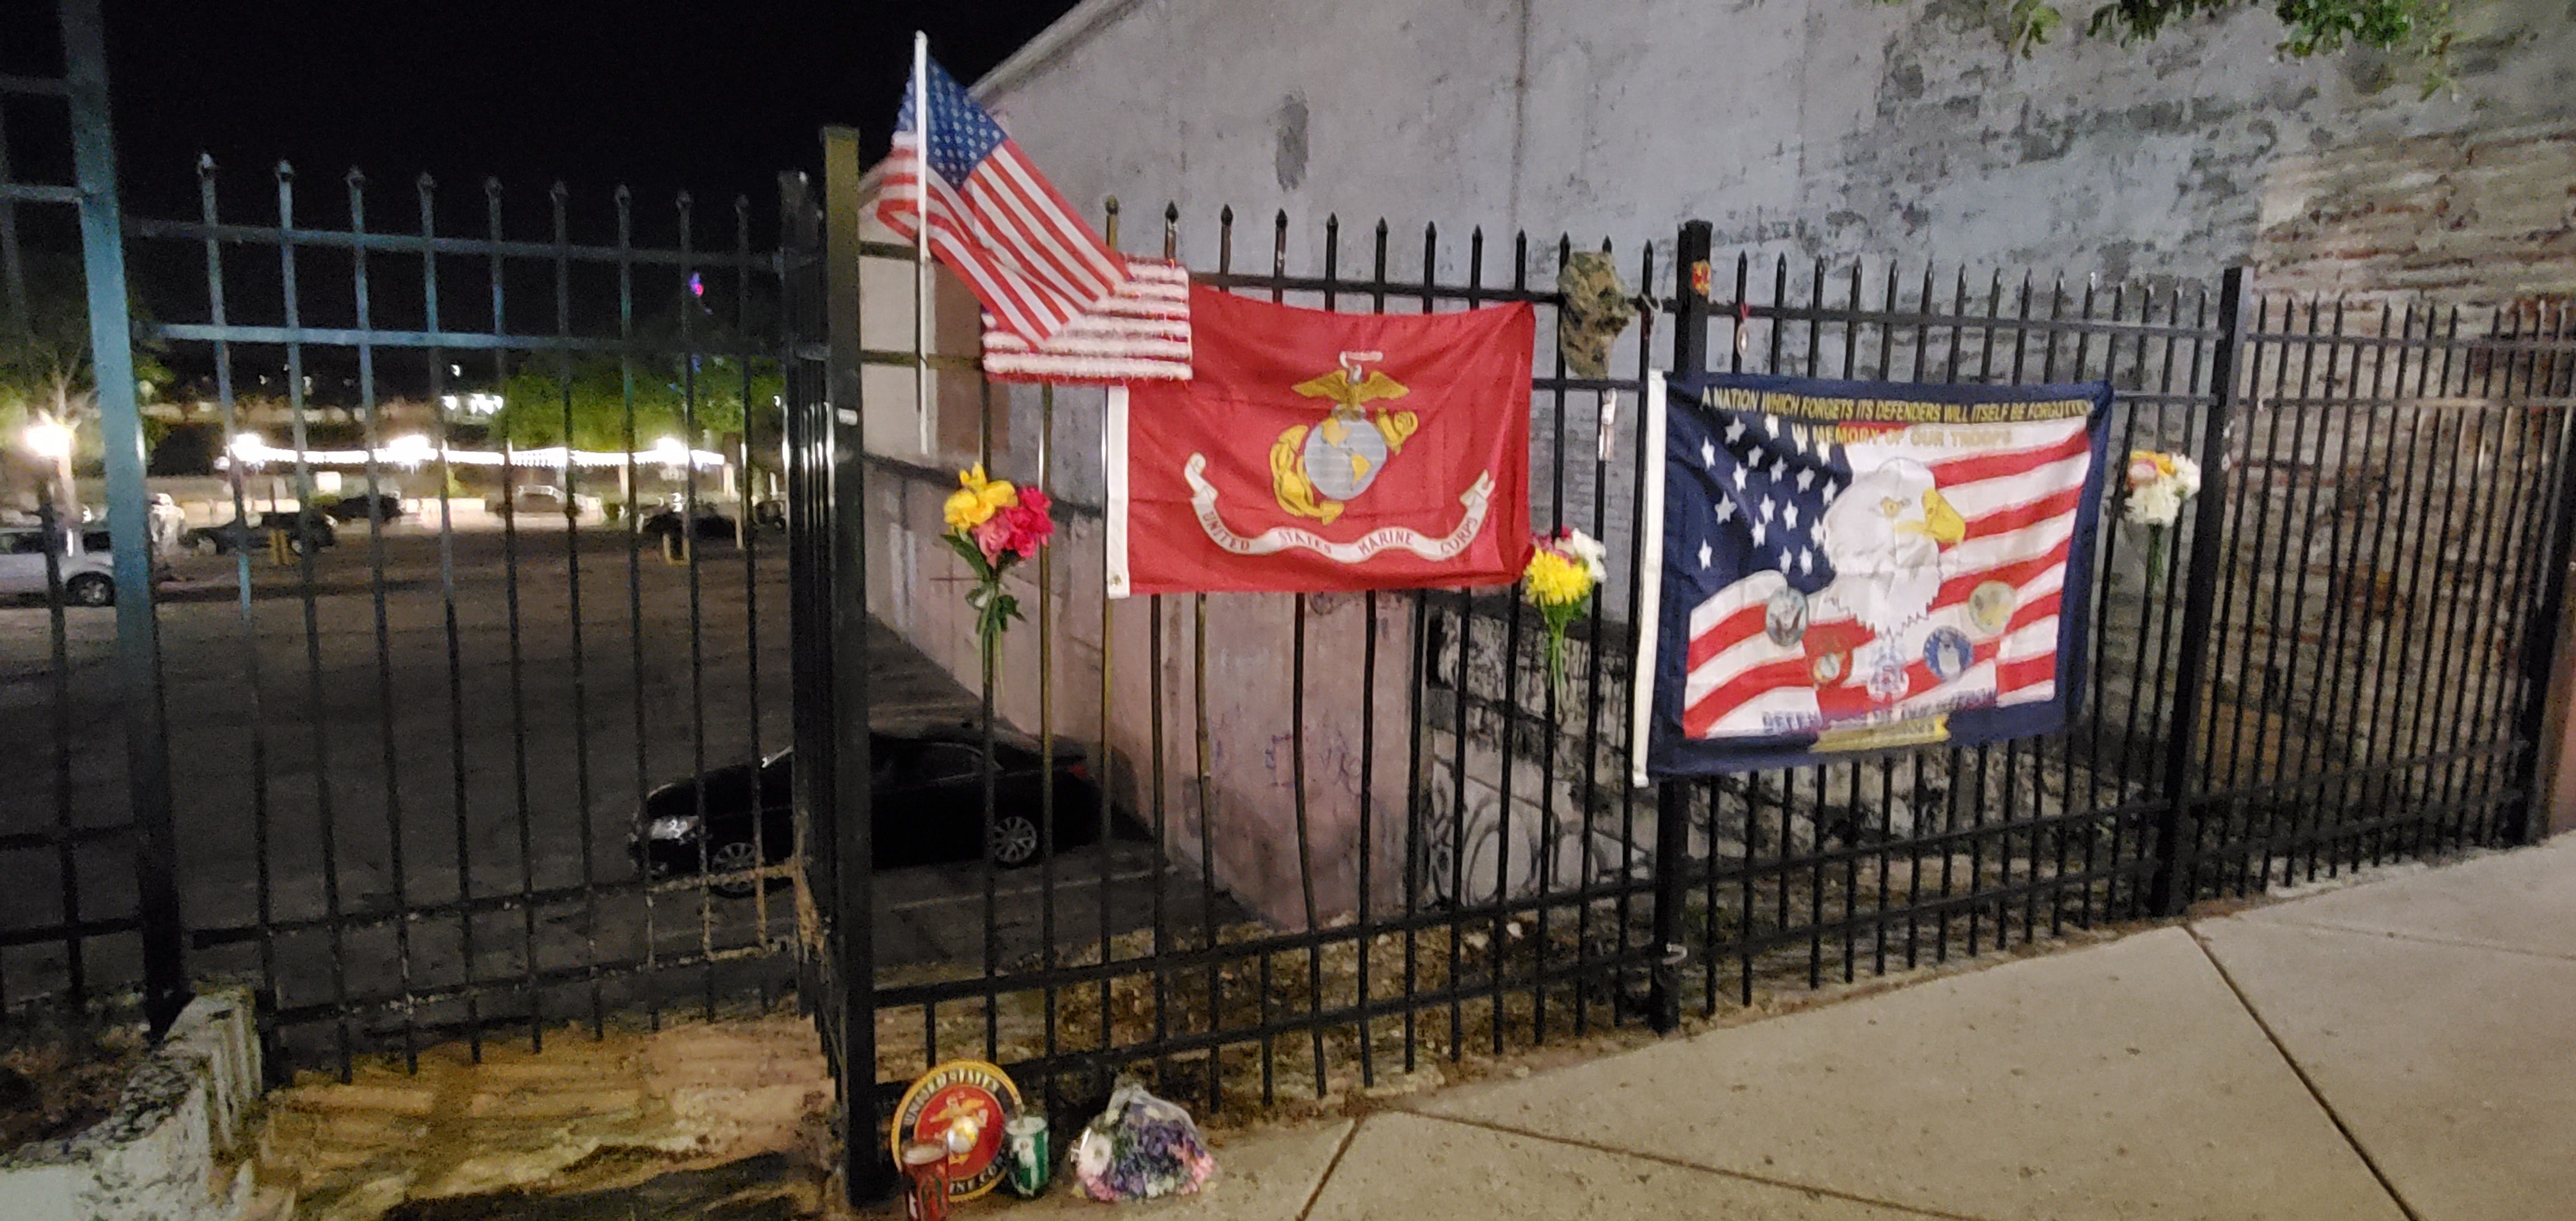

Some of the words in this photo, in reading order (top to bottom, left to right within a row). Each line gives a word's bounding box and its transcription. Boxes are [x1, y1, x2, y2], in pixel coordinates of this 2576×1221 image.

[1701, 385, 1712, 408] A
[1713, 386, 1759, 412] NATION
[1761, 391, 1800, 417] WHICH
[1801, 396, 1854, 421] FORGETS
[1856, 398, 1874, 420] ITS
[1875, 399, 1942, 422] DEFENDERS
[1971, 402, 2009, 423] ITSELF
[2010, 401, 2026, 420] BE
[1812, 424, 1880, 444] MEMORY
[1884, 427, 1904, 445] OF
[1909, 429, 1945, 446] OUR
[1202, 511, 1251, 551] UNITED
[1278, 531, 1332, 554] STATES
[1357, 529, 1413, 555] MARINE
[1440, 517, 1478, 555] CORPS
